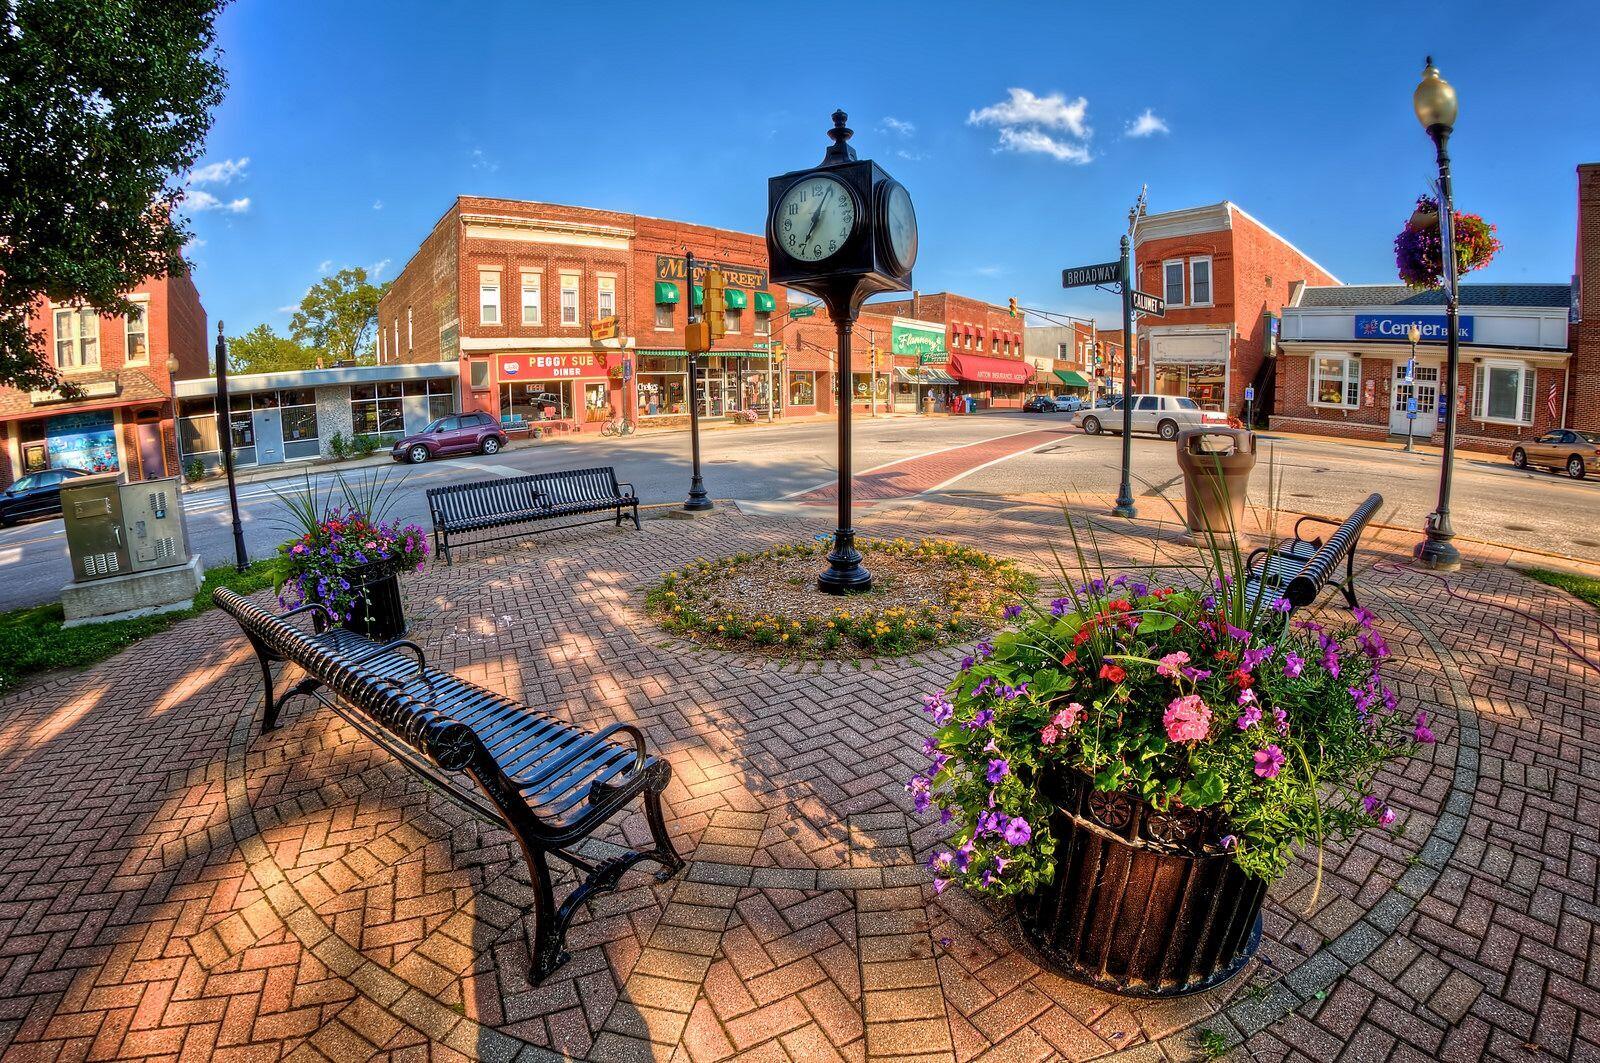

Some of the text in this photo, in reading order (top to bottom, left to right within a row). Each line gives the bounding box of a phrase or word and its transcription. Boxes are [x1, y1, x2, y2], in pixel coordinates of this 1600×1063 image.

[800, 190, 807, 203] 11
[811, 184, 824, 197] 12
[838, 195, 848, 207] 2
[788, 203, 798, 216] 10
[842, 209, 853, 223] 3
[784, 218, 793, 232] 9
[840, 227, 848, 239] 4
[789, 233, 796, 247] 8
[828, 239, 837, 252] 5
[799, 243, 807, 256] 7
[813, 244, 822, 258] 6
[1067, 265, 1117, 285] BROADWAY
[1133, 293, 1158, 313] CALUMET
[1440, 327, 1469, 337] BNK
[529, 356, 567, 368] PEGGY
[552, 368, 582, 377] DINER
